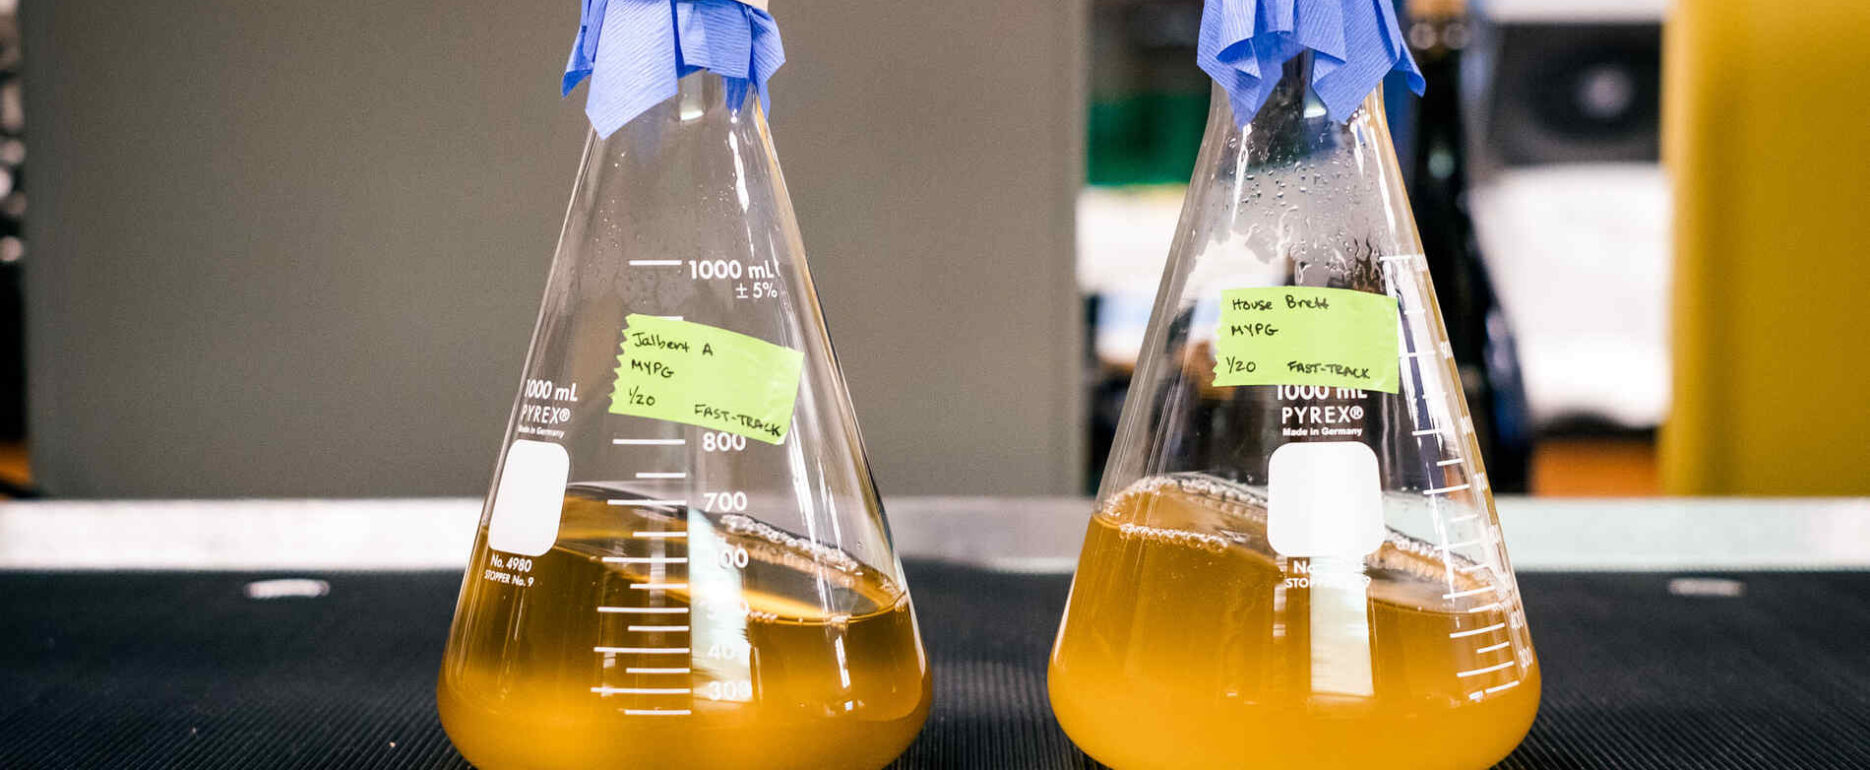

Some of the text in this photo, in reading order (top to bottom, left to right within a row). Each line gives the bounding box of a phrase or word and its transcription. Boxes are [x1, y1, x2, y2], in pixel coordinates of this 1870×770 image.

[688, 260, 774, 279] 1000 mL
[753, 282, 778, 298] 5%
[1232, 294, 1329, 311] House Brett
[1231, 323, 1278, 337] MYPG
[702, 343, 713, 356] A
[631, 359, 675, 378] MYPG
[1226, 356, 1371, 379] 1/20 FAST-TRACK
[524, 379, 578, 401] 1000 mL
[628, 385, 782, 437] 1/20 FAST-TRACK
[1282, 426, 1363, 437] Made in Germany
[702, 432, 746, 451] 800
[703, 491, 748, 511] 700
[490, 552, 532, 573] No. 4980
[706, 548, 749, 568] 00
[484, 569, 534, 587] STOPPER No. 9
[706, 643, 747, 660] 40
